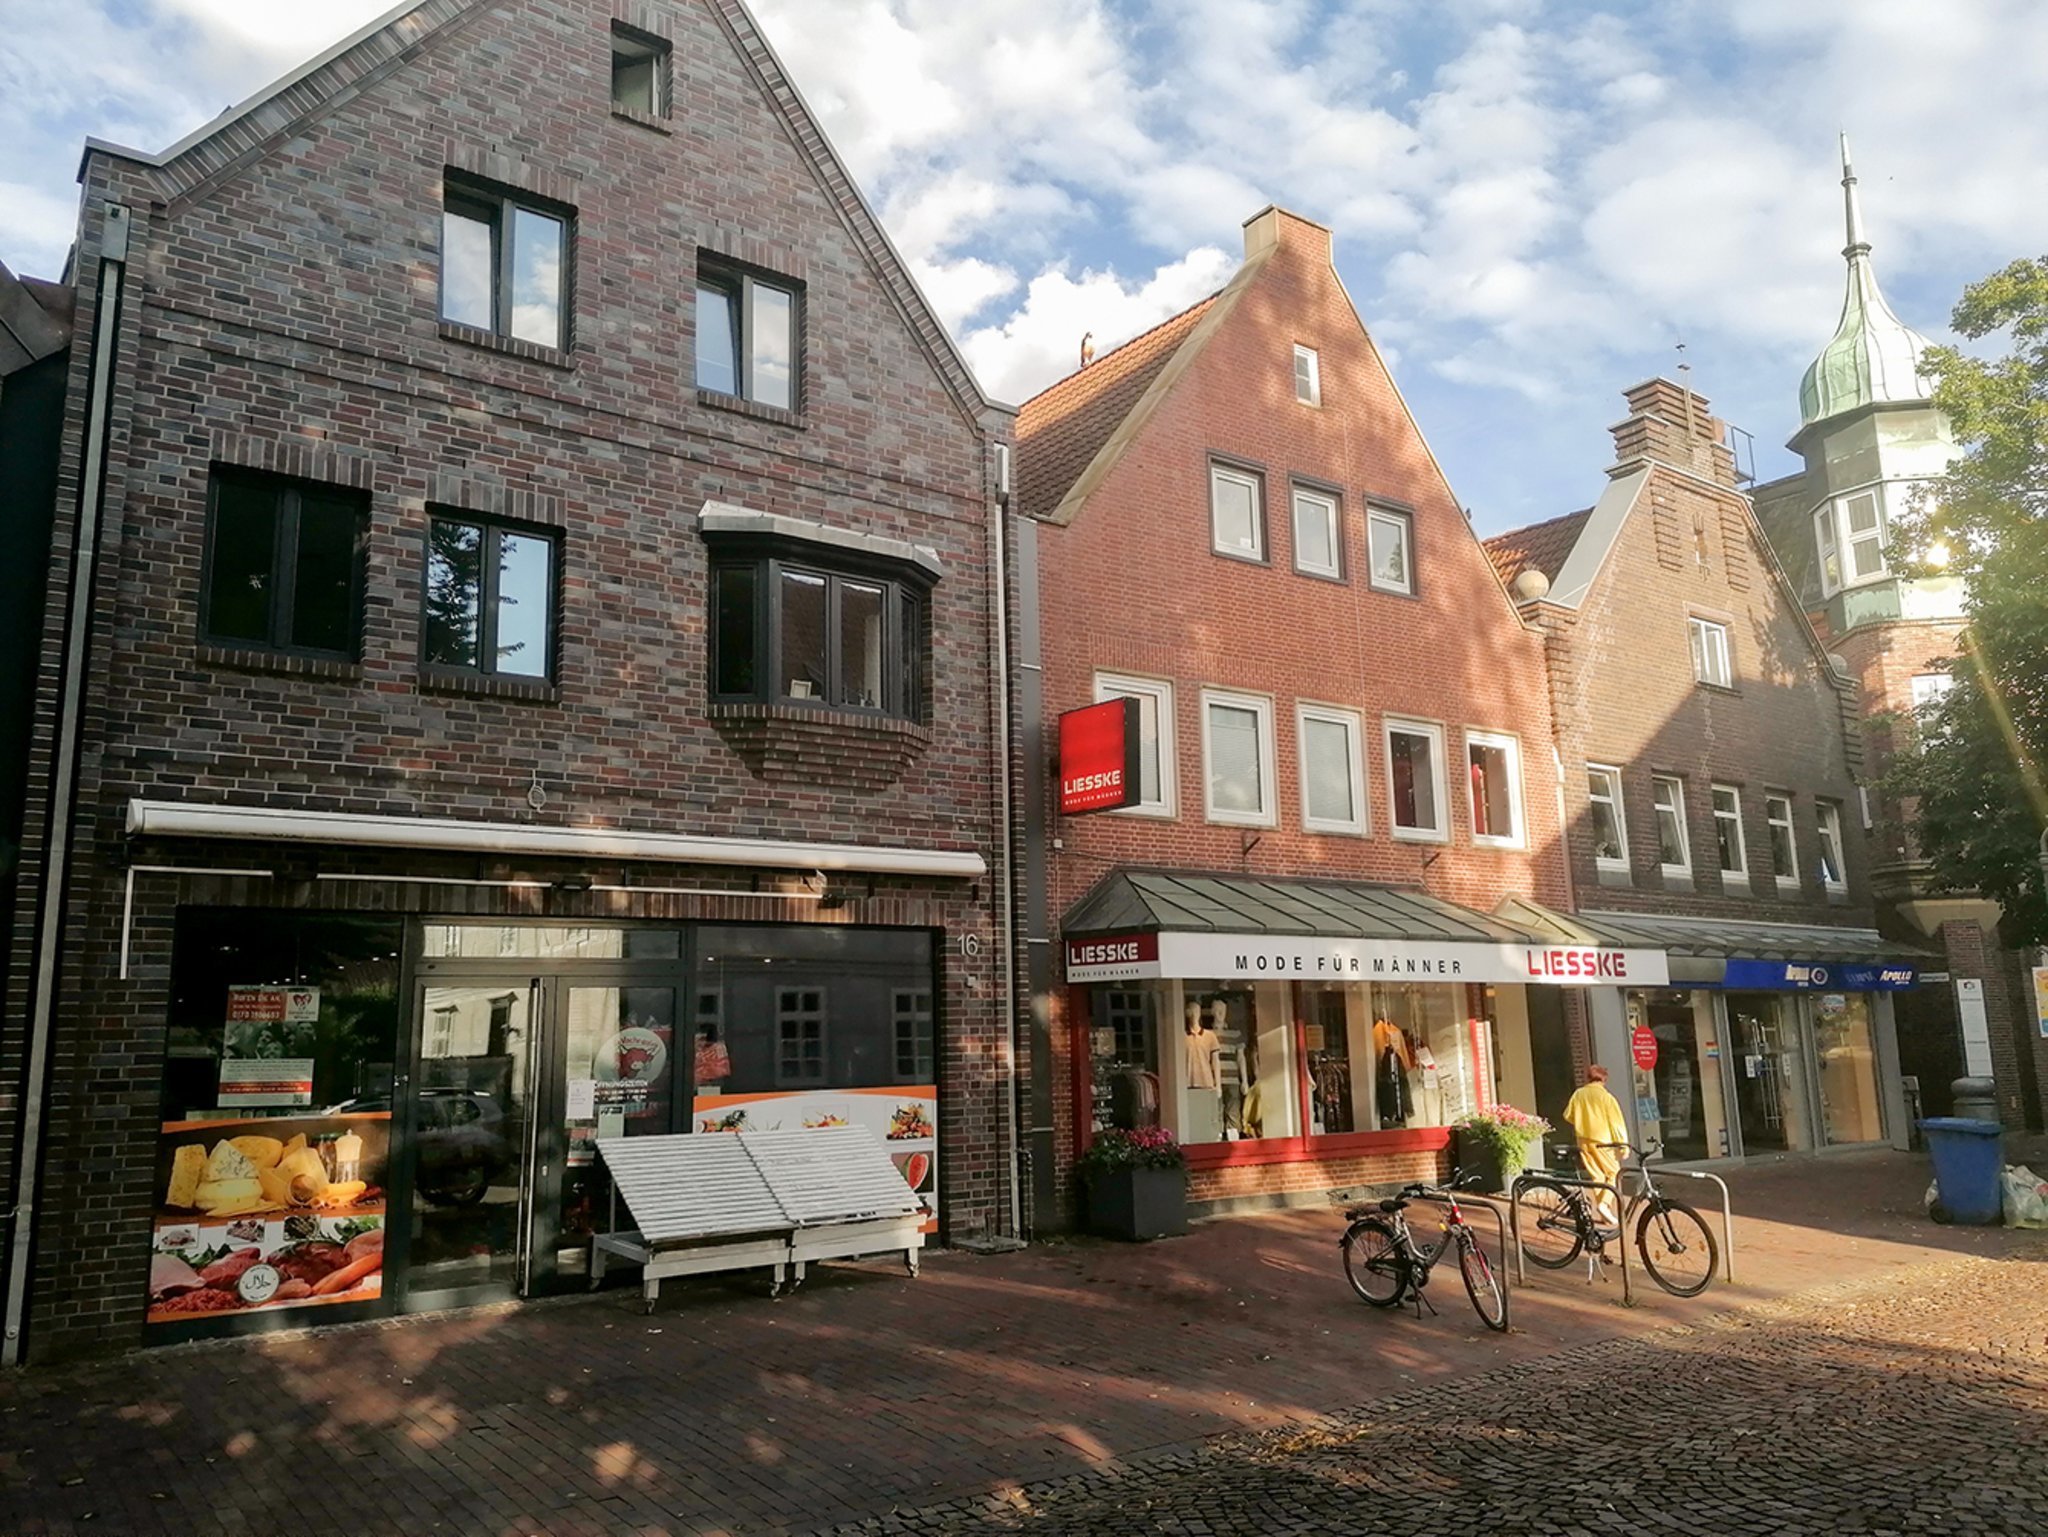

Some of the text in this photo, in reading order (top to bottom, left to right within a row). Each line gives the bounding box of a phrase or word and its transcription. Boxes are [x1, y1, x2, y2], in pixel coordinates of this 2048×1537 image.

[1064, 769, 1121, 795] LIESSKE
[957, 933, 978, 956] 16
[1071, 942, 1139, 964] LIESSKE
[1235, 953, 1462, 974] MODE FÜR MÄNNER
[1527, 950, 1627, 977] LIESSKE
